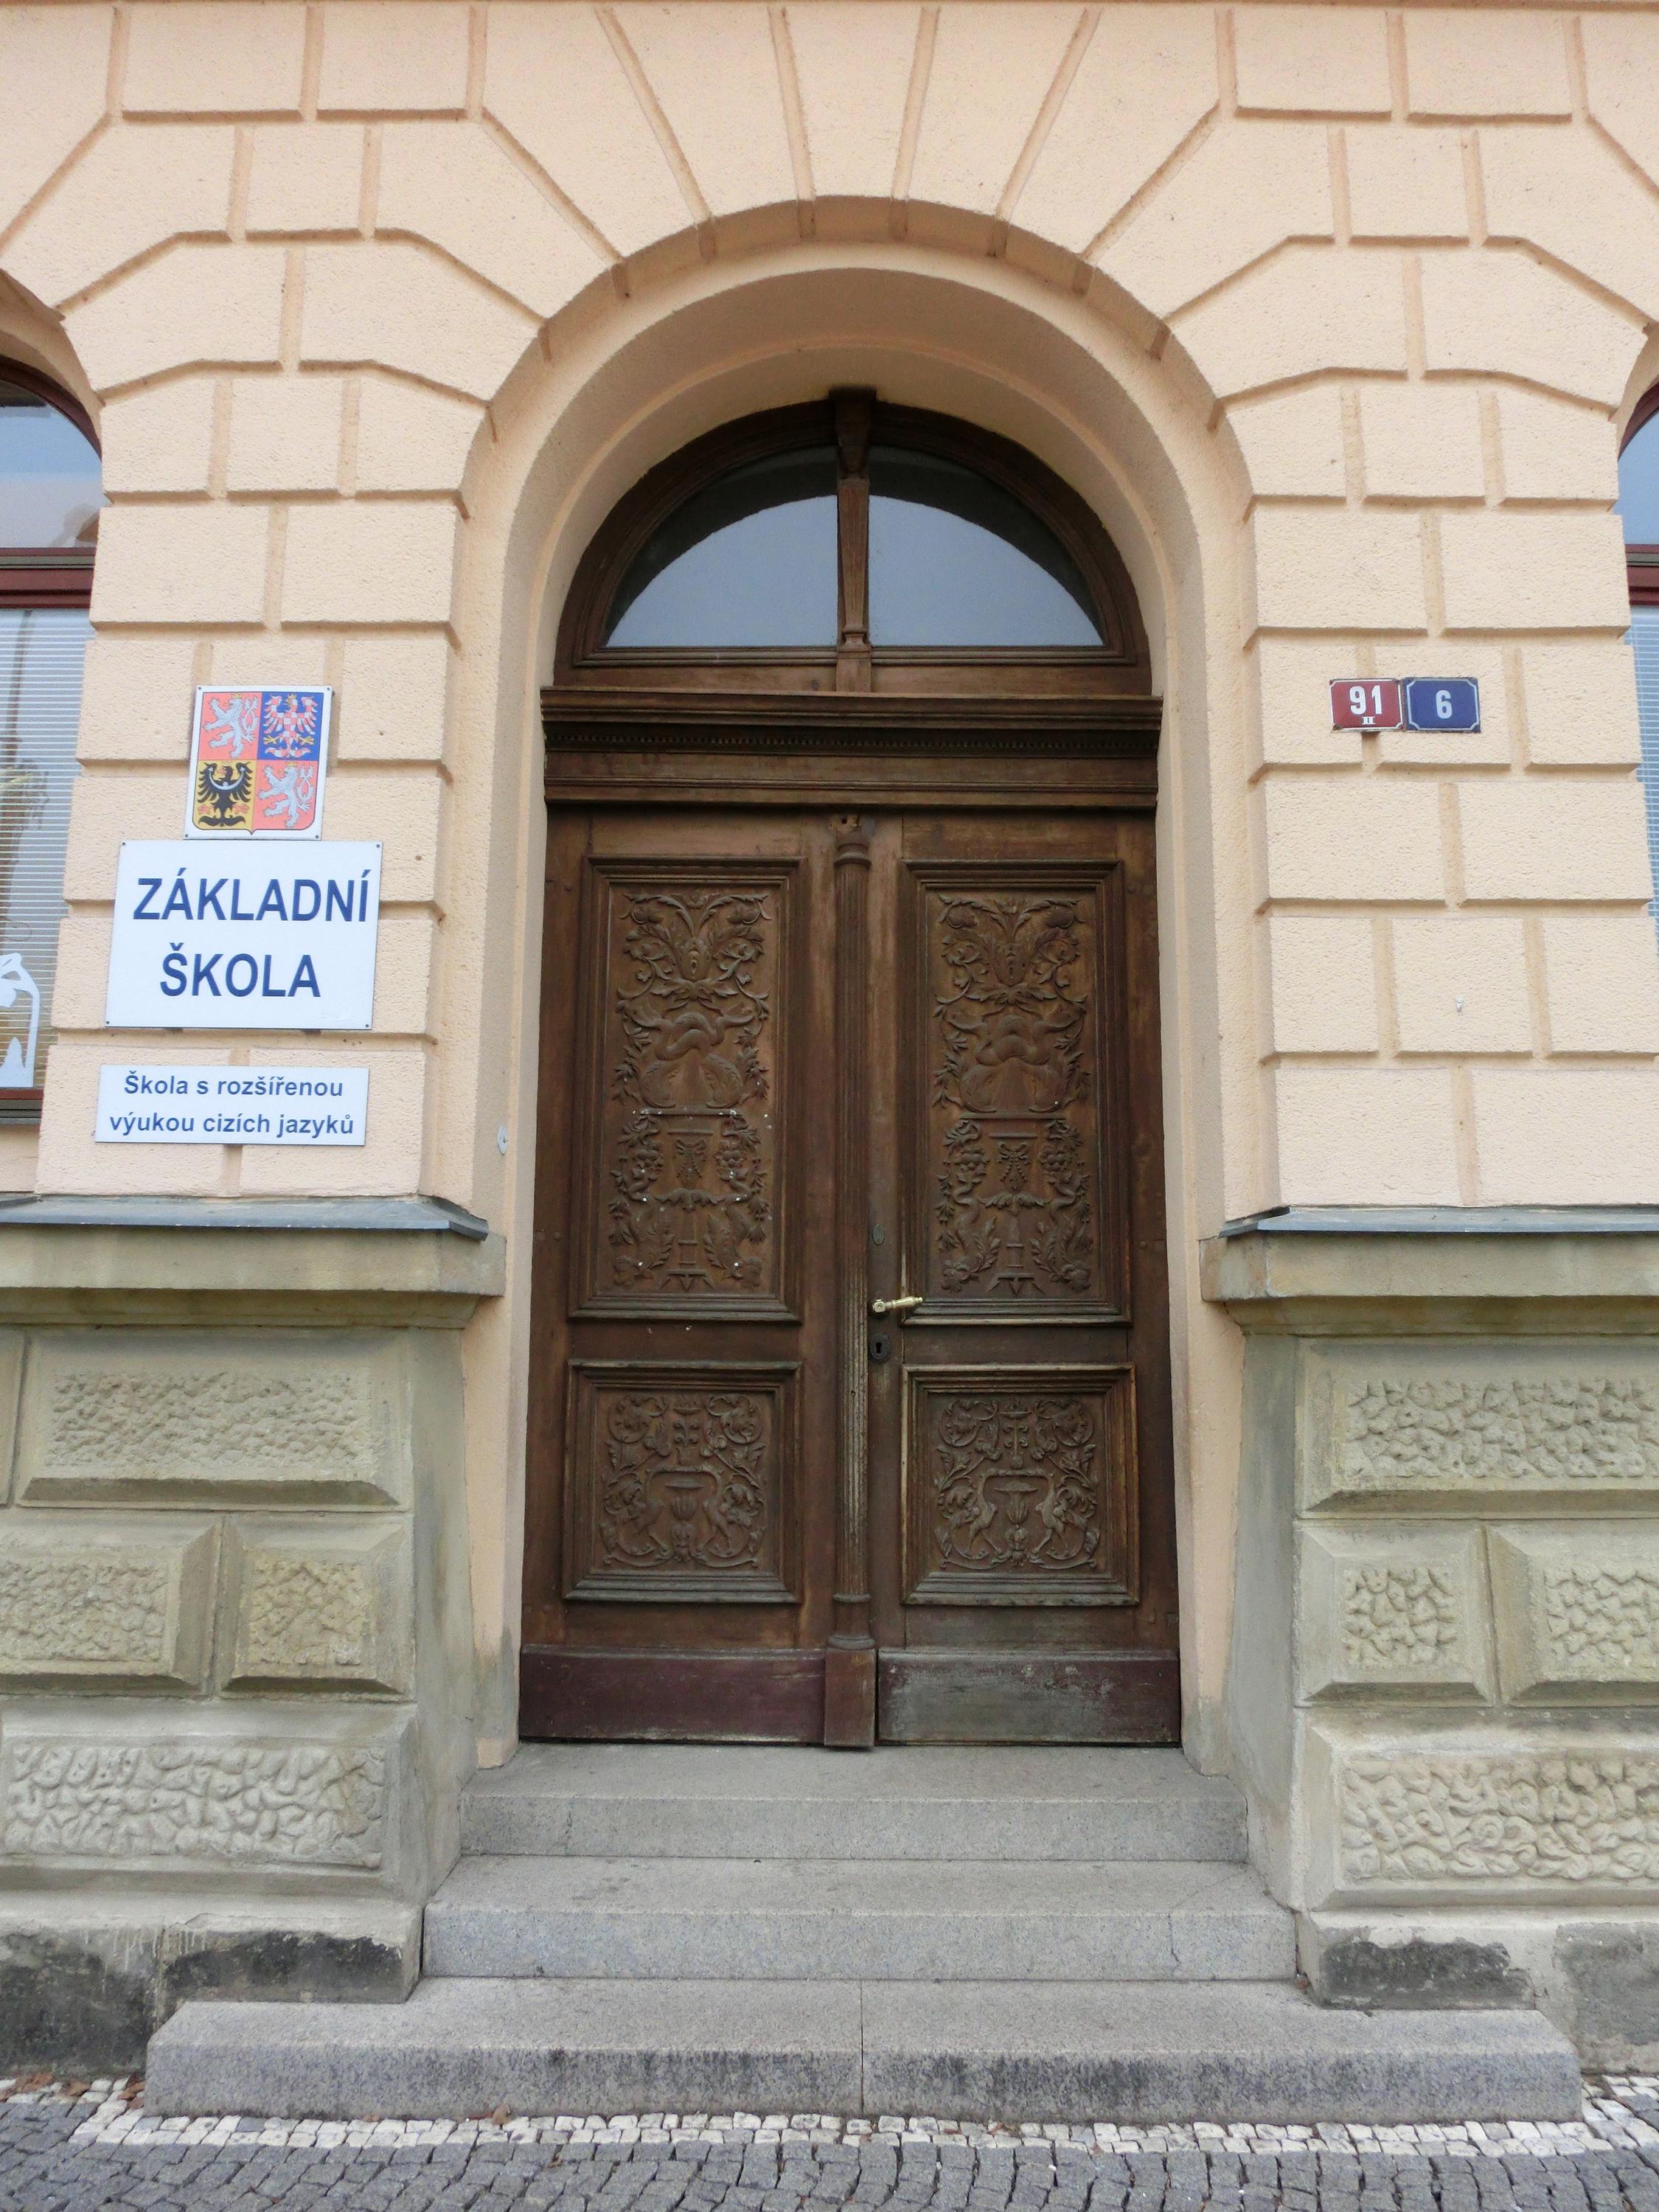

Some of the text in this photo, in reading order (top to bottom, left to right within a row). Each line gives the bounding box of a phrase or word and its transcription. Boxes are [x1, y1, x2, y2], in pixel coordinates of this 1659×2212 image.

[1349, 684, 1382, 715] 91
[1436, 689, 1453, 719] 6
[133, 867, 371, 922] ZÁKLADNÍ
[159, 942, 321, 998] ŠKOLA
[124, 1070, 344, 1096] Škola s rozšířenou
[110, 1111, 354, 1139] výukou cizích jazyků
